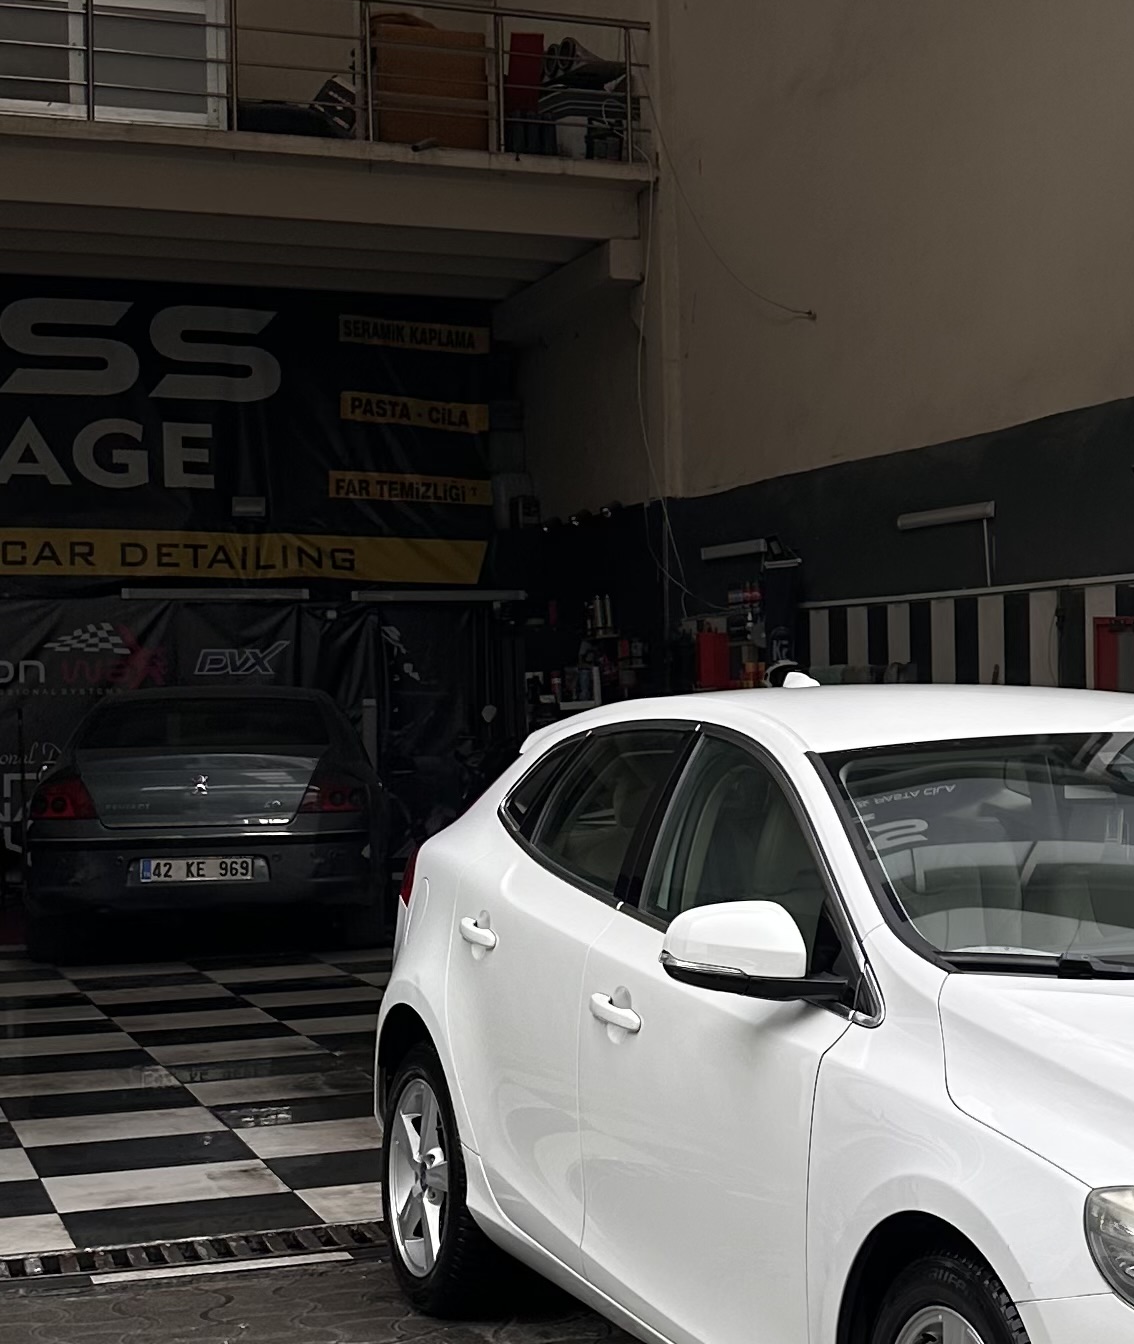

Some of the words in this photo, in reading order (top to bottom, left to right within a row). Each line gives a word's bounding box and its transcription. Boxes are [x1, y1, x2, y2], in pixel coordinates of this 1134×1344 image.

[409, 326, 476, 350] KAPLAMA
[350, 396, 411, 421] PASTA
[0, 415, 216, 490] AGE
[335, 478, 370, 498] FAR
[1, 540, 96, 567] CAR
[120, 542, 356, 572] DETAILING
[152, 861, 173, 878] 42
[186, 861, 206, 878] KE
[218, 860, 249, 877] 969
